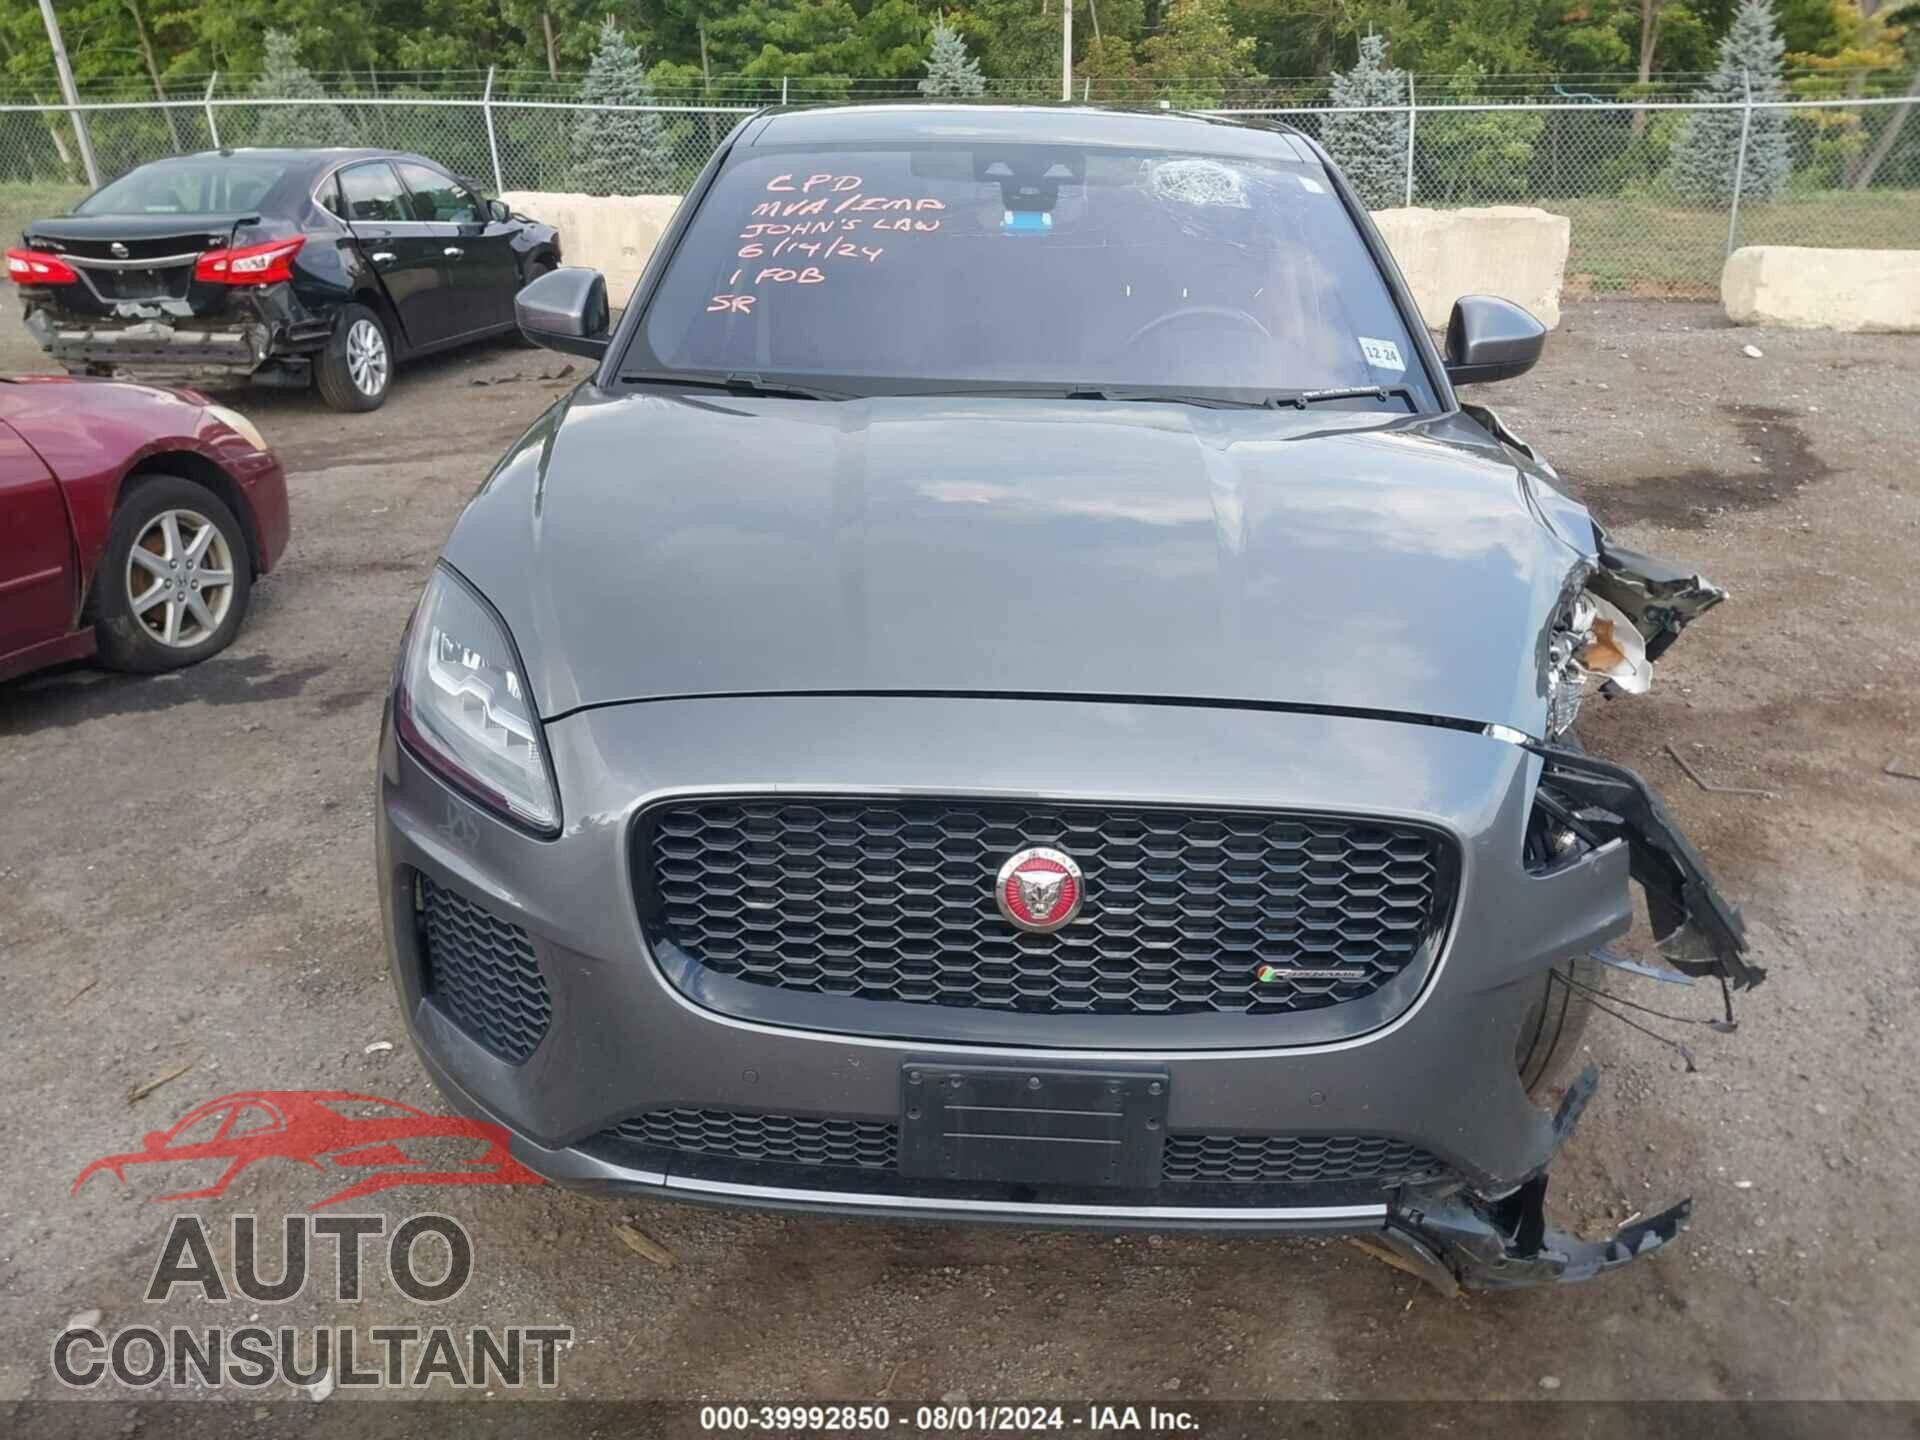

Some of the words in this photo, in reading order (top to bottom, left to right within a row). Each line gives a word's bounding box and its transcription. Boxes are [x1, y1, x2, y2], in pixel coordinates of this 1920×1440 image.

[766, 174, 860, 193] CPD
[740, 218, 863, 238] JOHN'S
[873, 218, 940, 232] LAW
[738, 236, 884, 262] 6/14/24
[755, 267, 825, 284] FOB
[707, 294, 756, 314] SR
